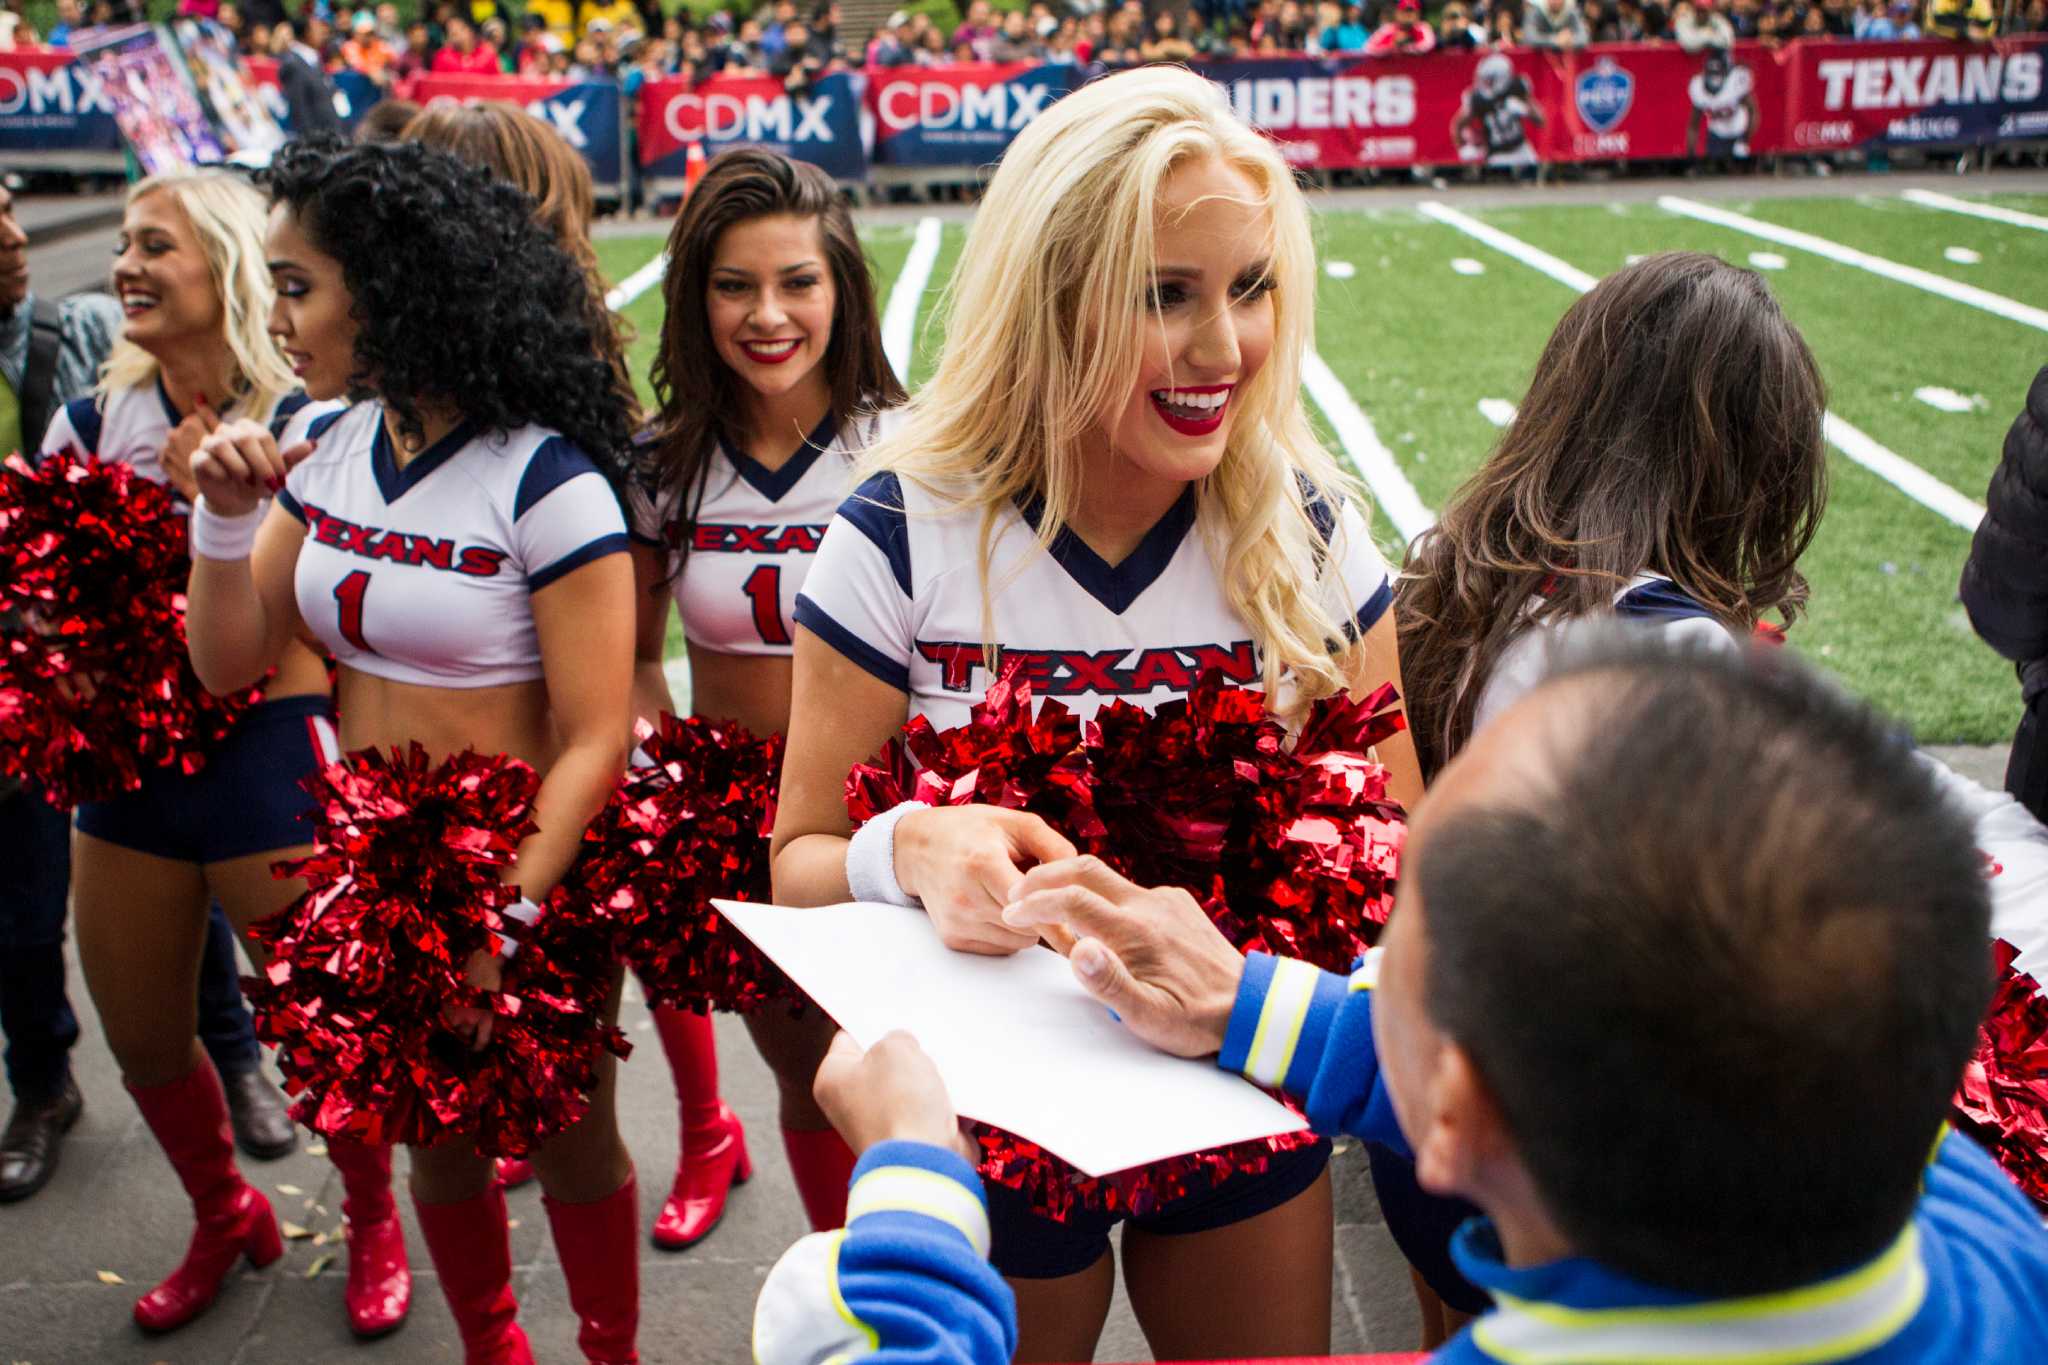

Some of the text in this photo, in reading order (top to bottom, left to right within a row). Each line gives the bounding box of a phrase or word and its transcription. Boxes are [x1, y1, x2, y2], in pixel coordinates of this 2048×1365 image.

[878, 80, 1048, 130] CDMX
[1818, 53, 2042, 111] TEXANS
[664, 93, 834, 141] CDMX
[303, 502, 510, 577] TEXANS
[333, 569, 378, 655] 1
[741, 564, 793, 646] 1
[915, 640, 1290, 695] TEXAN
